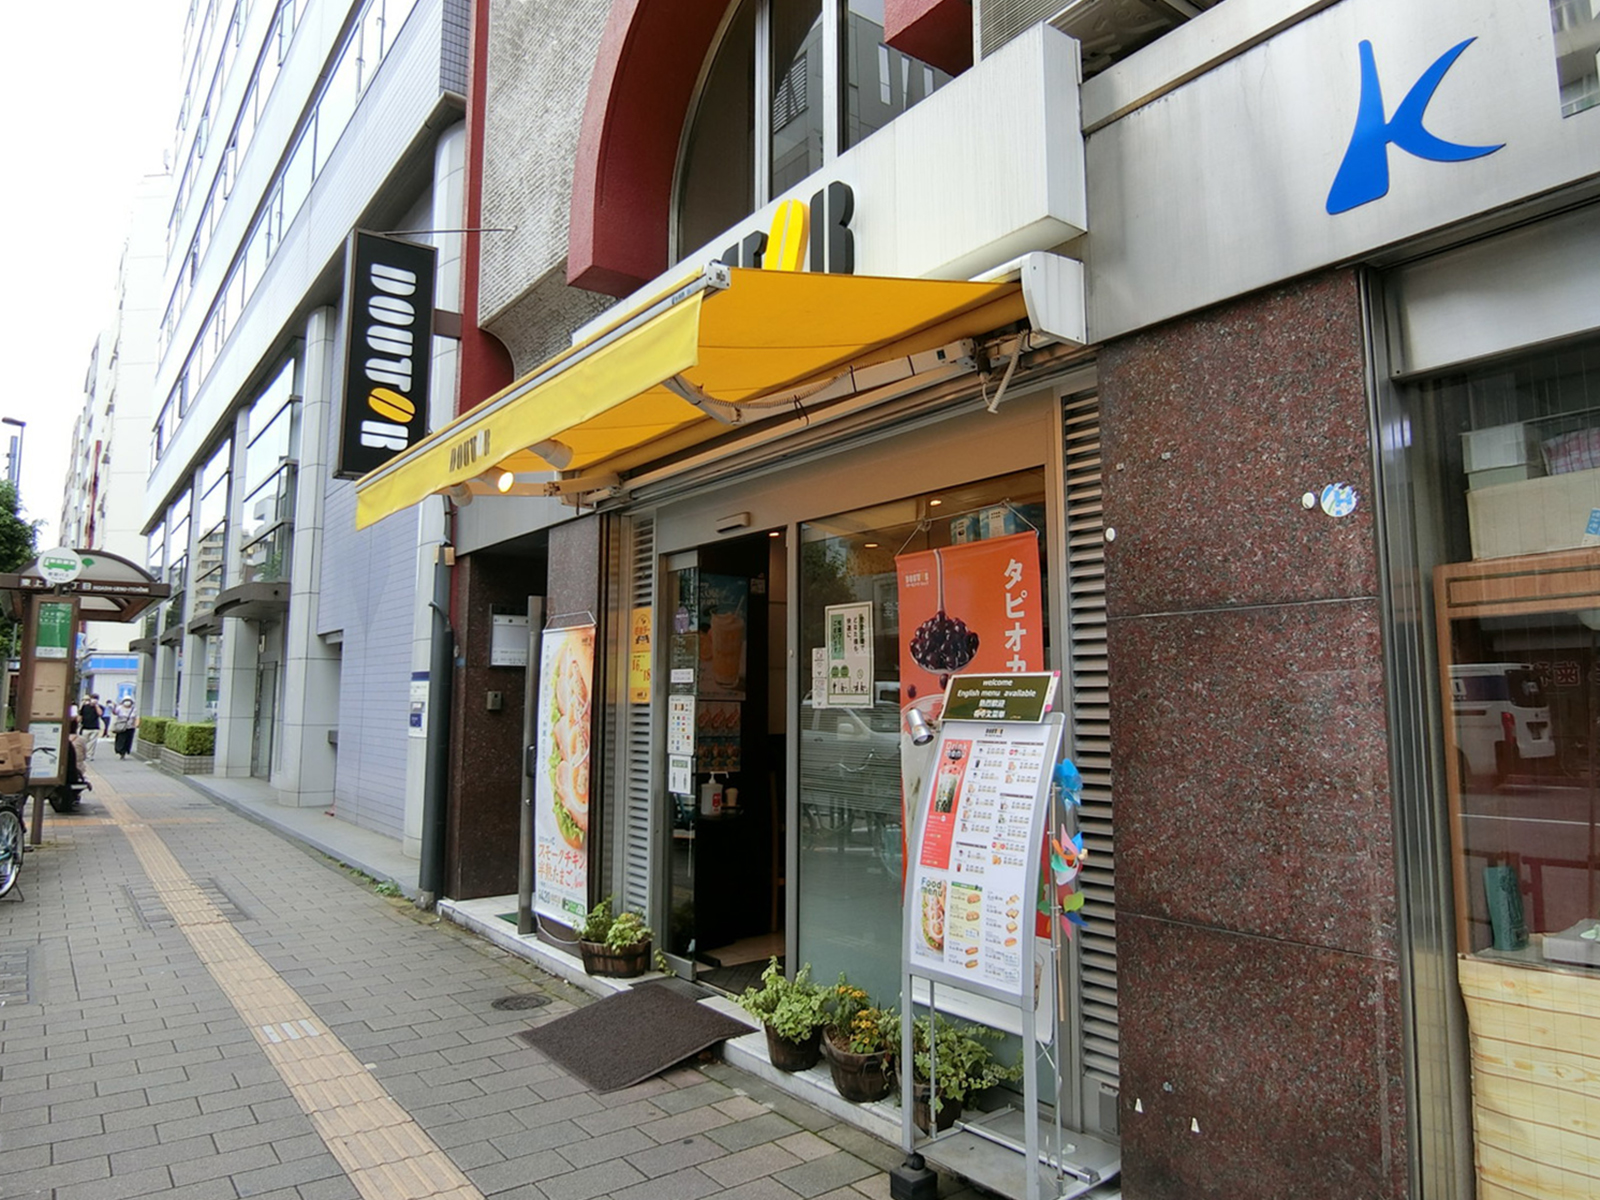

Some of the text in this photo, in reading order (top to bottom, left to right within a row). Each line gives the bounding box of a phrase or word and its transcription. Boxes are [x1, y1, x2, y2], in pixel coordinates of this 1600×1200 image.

[360, 262, 417, 452] DOUTOR
[448, 428, 492, 473] DOUTOR
[1004, 558, 1027, 672] タピオカ
[957, 689, 980, 698] English
[1003, 689, 1037, 697] available
[982, 678, 1013, 686] welcome
[921, 876, 942, 889] Food
